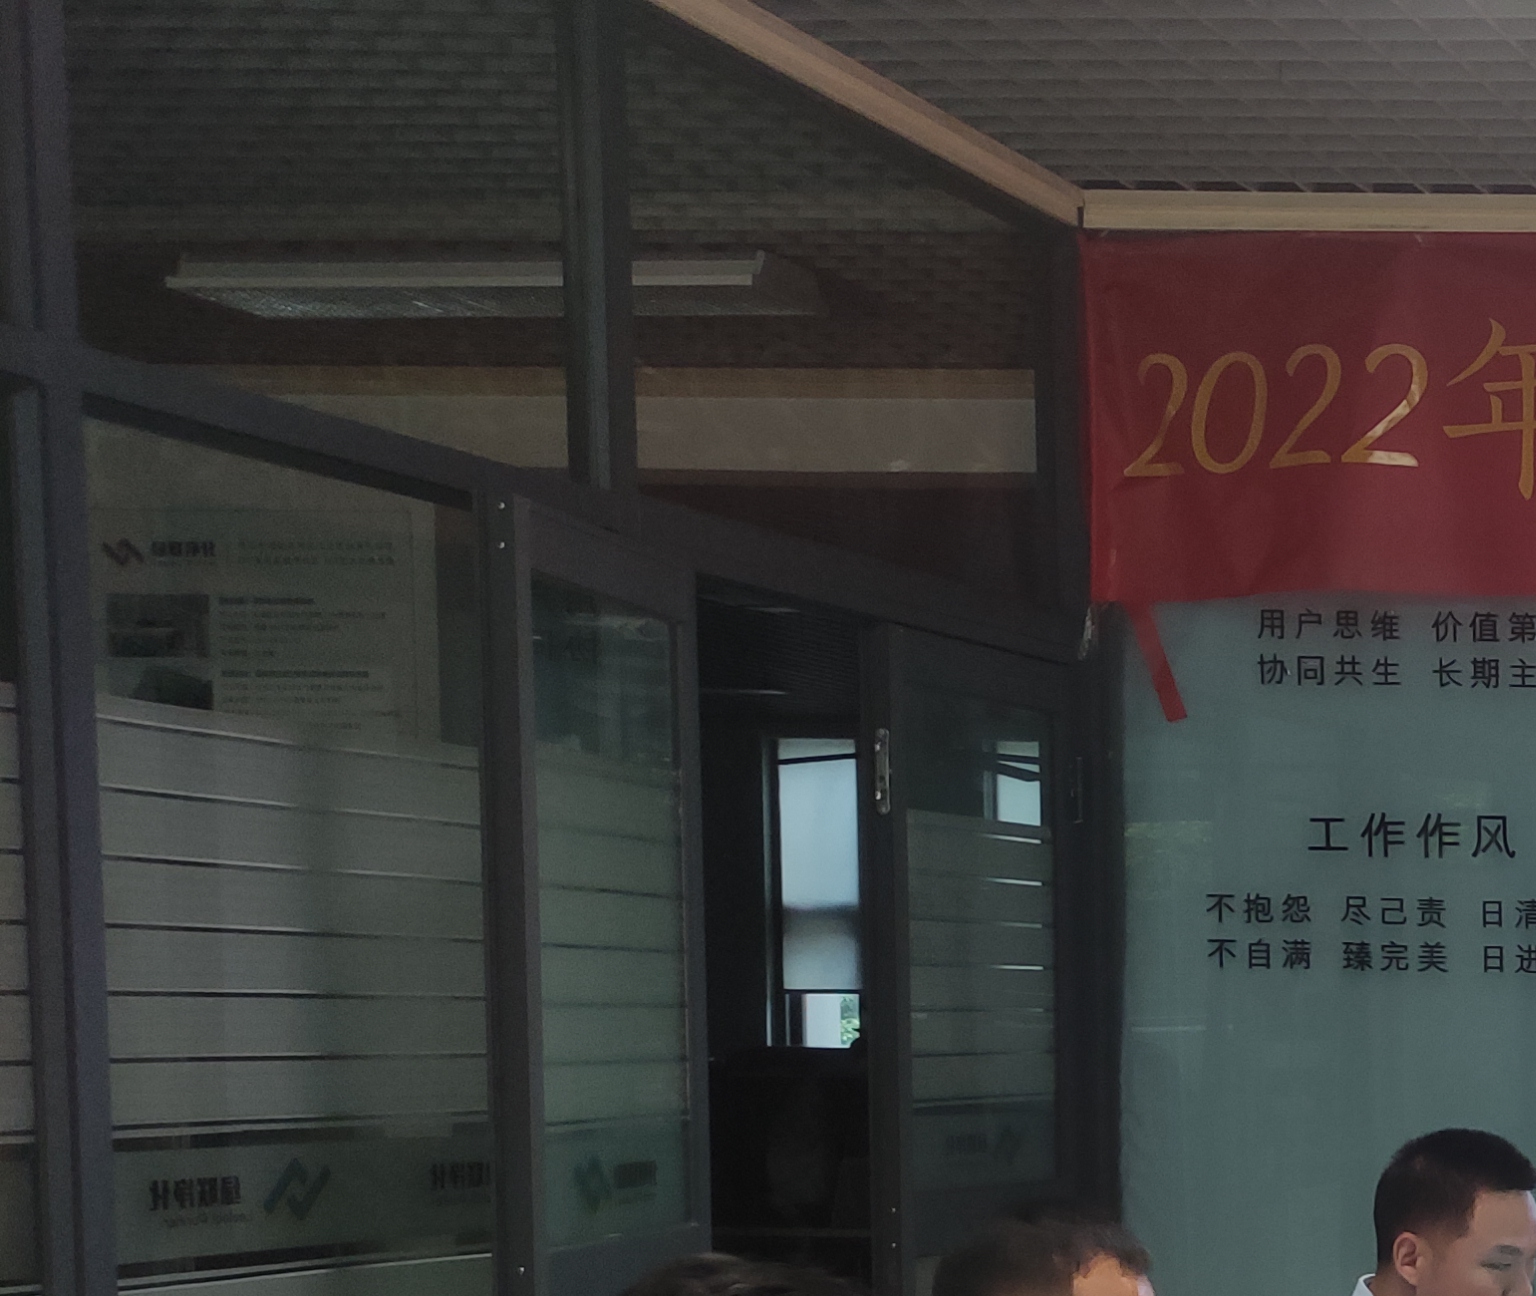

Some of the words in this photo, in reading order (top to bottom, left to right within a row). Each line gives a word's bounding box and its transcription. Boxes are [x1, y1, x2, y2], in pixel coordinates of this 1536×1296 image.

[1258, 608, 1401, 642] 用户思维
[1257, 654, 1402, 687] 协同共生
[1308, 812, 1517, 859] 工作作风
[1205, 893, 1313, 925] 不抱怨
[1340, 896, 1447, 928] 尽己责
[1207, 938, 1313, 970] 不自满
[1342, 941, 1449, 973] 臻完美
